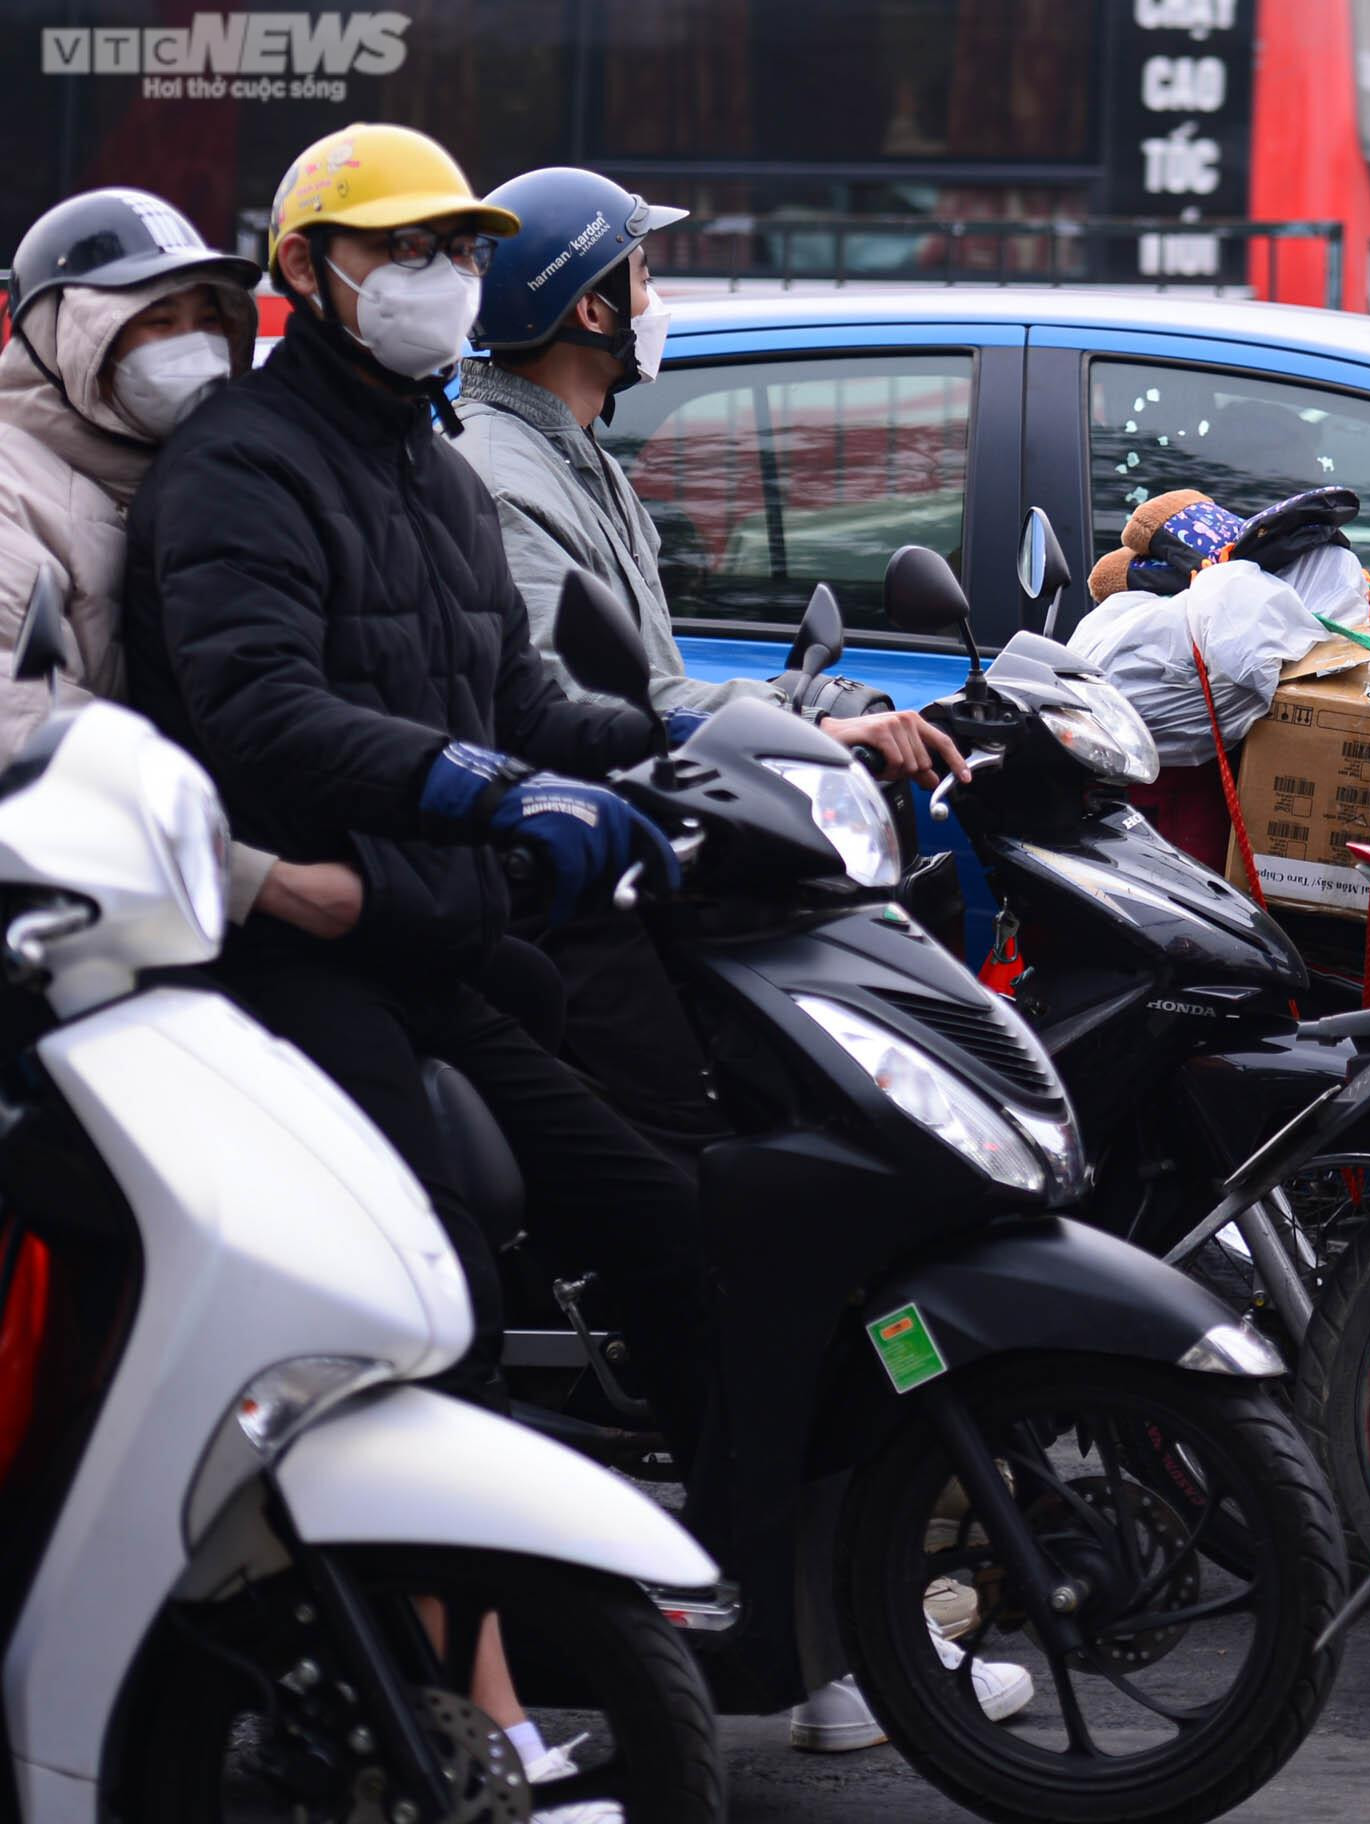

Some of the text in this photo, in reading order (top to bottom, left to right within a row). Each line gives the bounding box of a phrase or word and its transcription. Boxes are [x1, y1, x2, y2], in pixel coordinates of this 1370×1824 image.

[1142, 55, 1227, 112] CAO
[1140, 120, 1221, 195] TỐC
[1287, 875, 1309, 886] Taro
[1146, 999, 1217, 1018] HONDA
